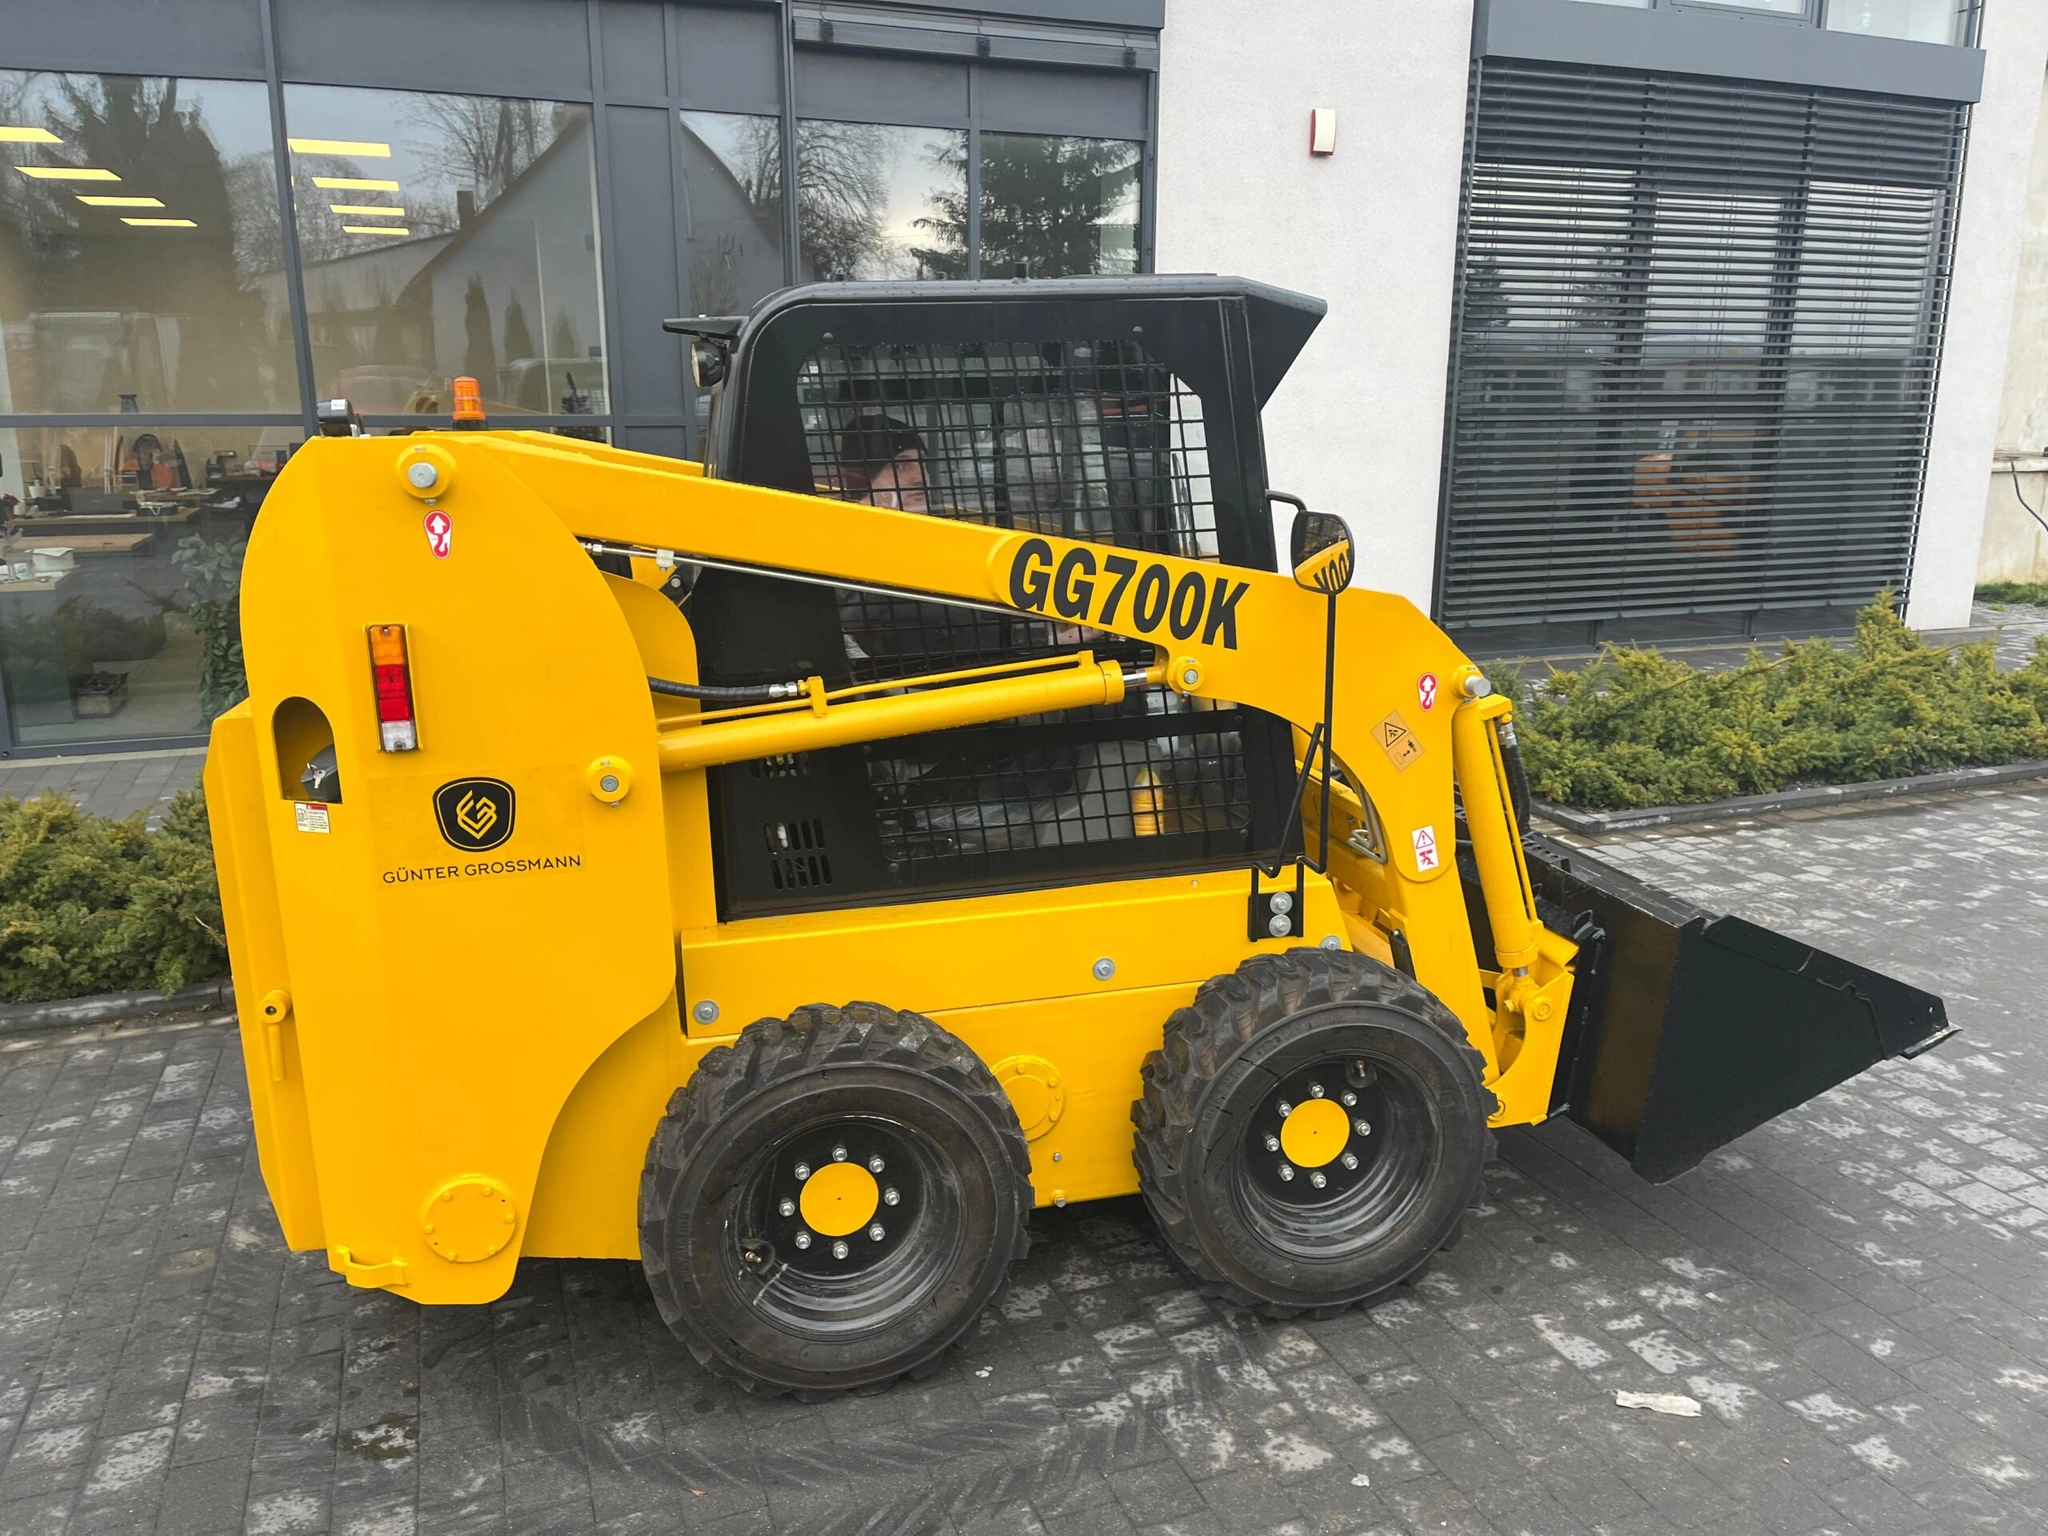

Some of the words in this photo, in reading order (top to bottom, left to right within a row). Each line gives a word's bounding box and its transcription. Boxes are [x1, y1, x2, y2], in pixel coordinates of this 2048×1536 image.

[1009, 538, 1250, 650] GG700K
[382, 866, 460, 884] GÜNTER
[465, 855, 581, 877] GROSSMANN
